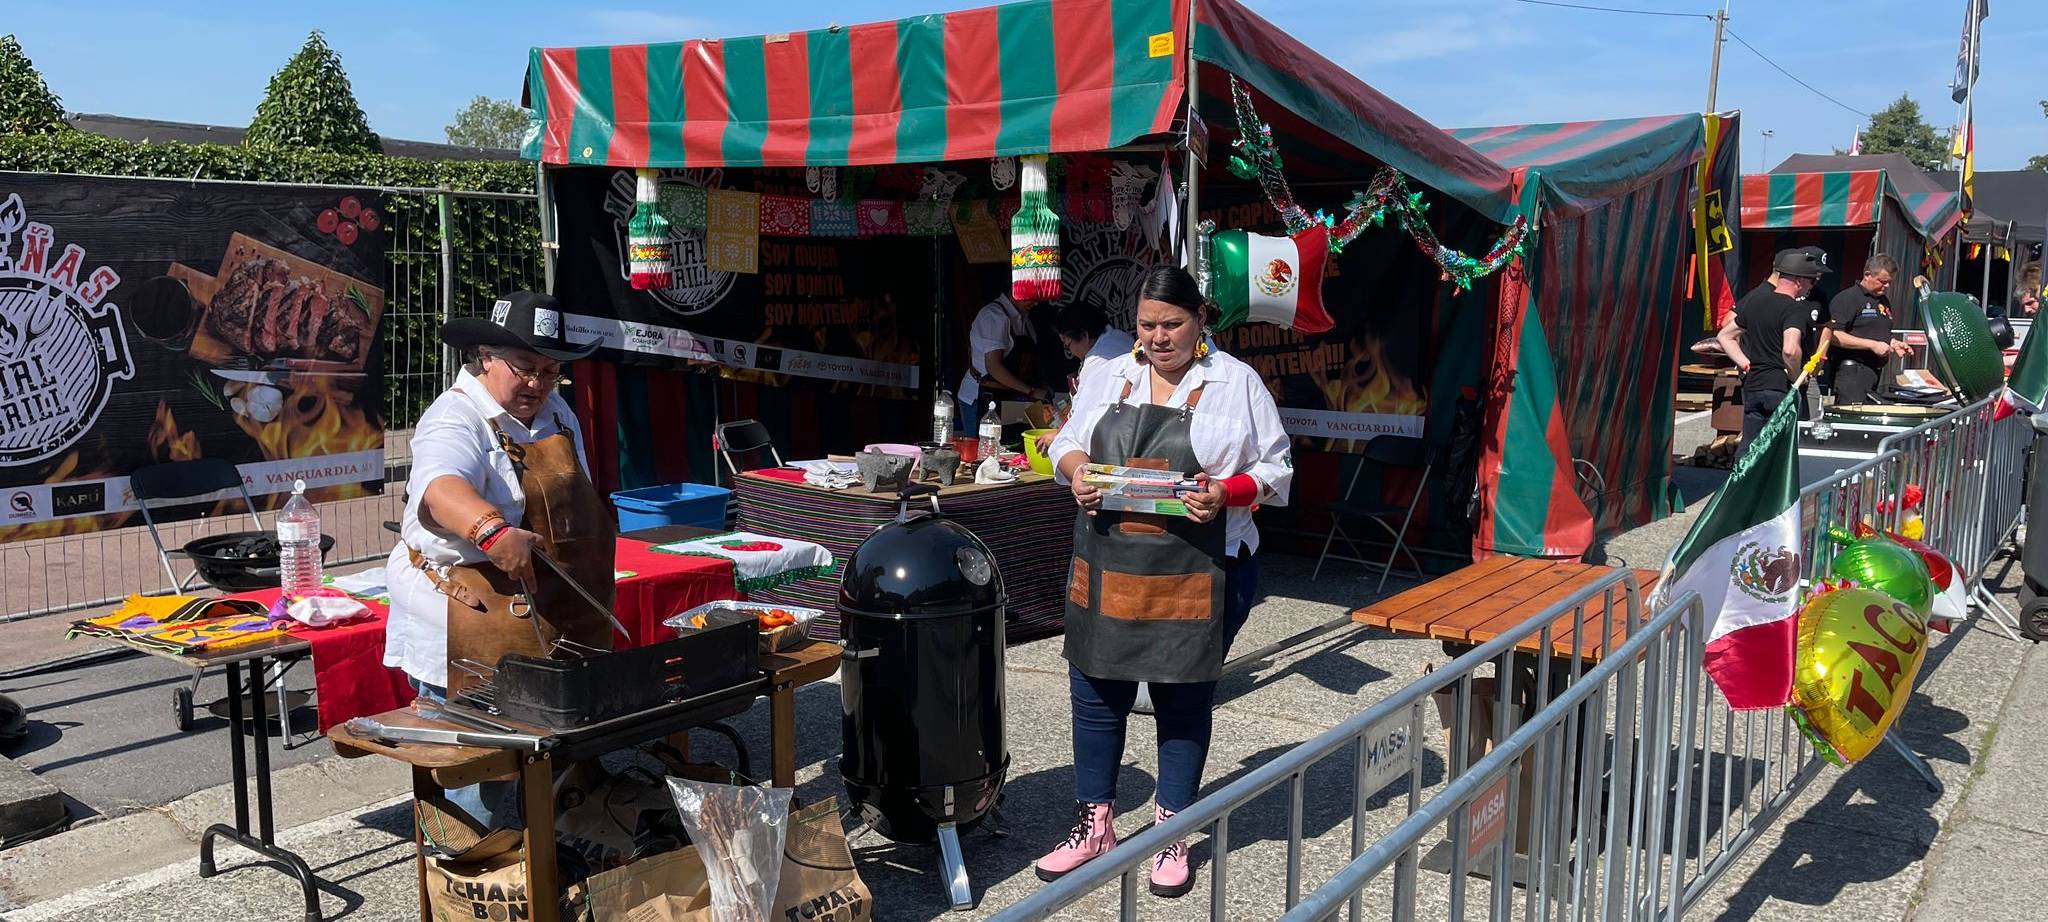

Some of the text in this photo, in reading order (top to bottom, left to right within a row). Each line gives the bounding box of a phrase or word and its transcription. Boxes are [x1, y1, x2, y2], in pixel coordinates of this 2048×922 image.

[1286, 416, 1318, 427] TOYOTA
[1326, 421, 1405, 434] VANGUARDIA
[266, 465, 358, 485] VANGUARDIA
[1366, 725, 1412, 769] MASSA
[1471, 791, 1506, 834] MASSA
